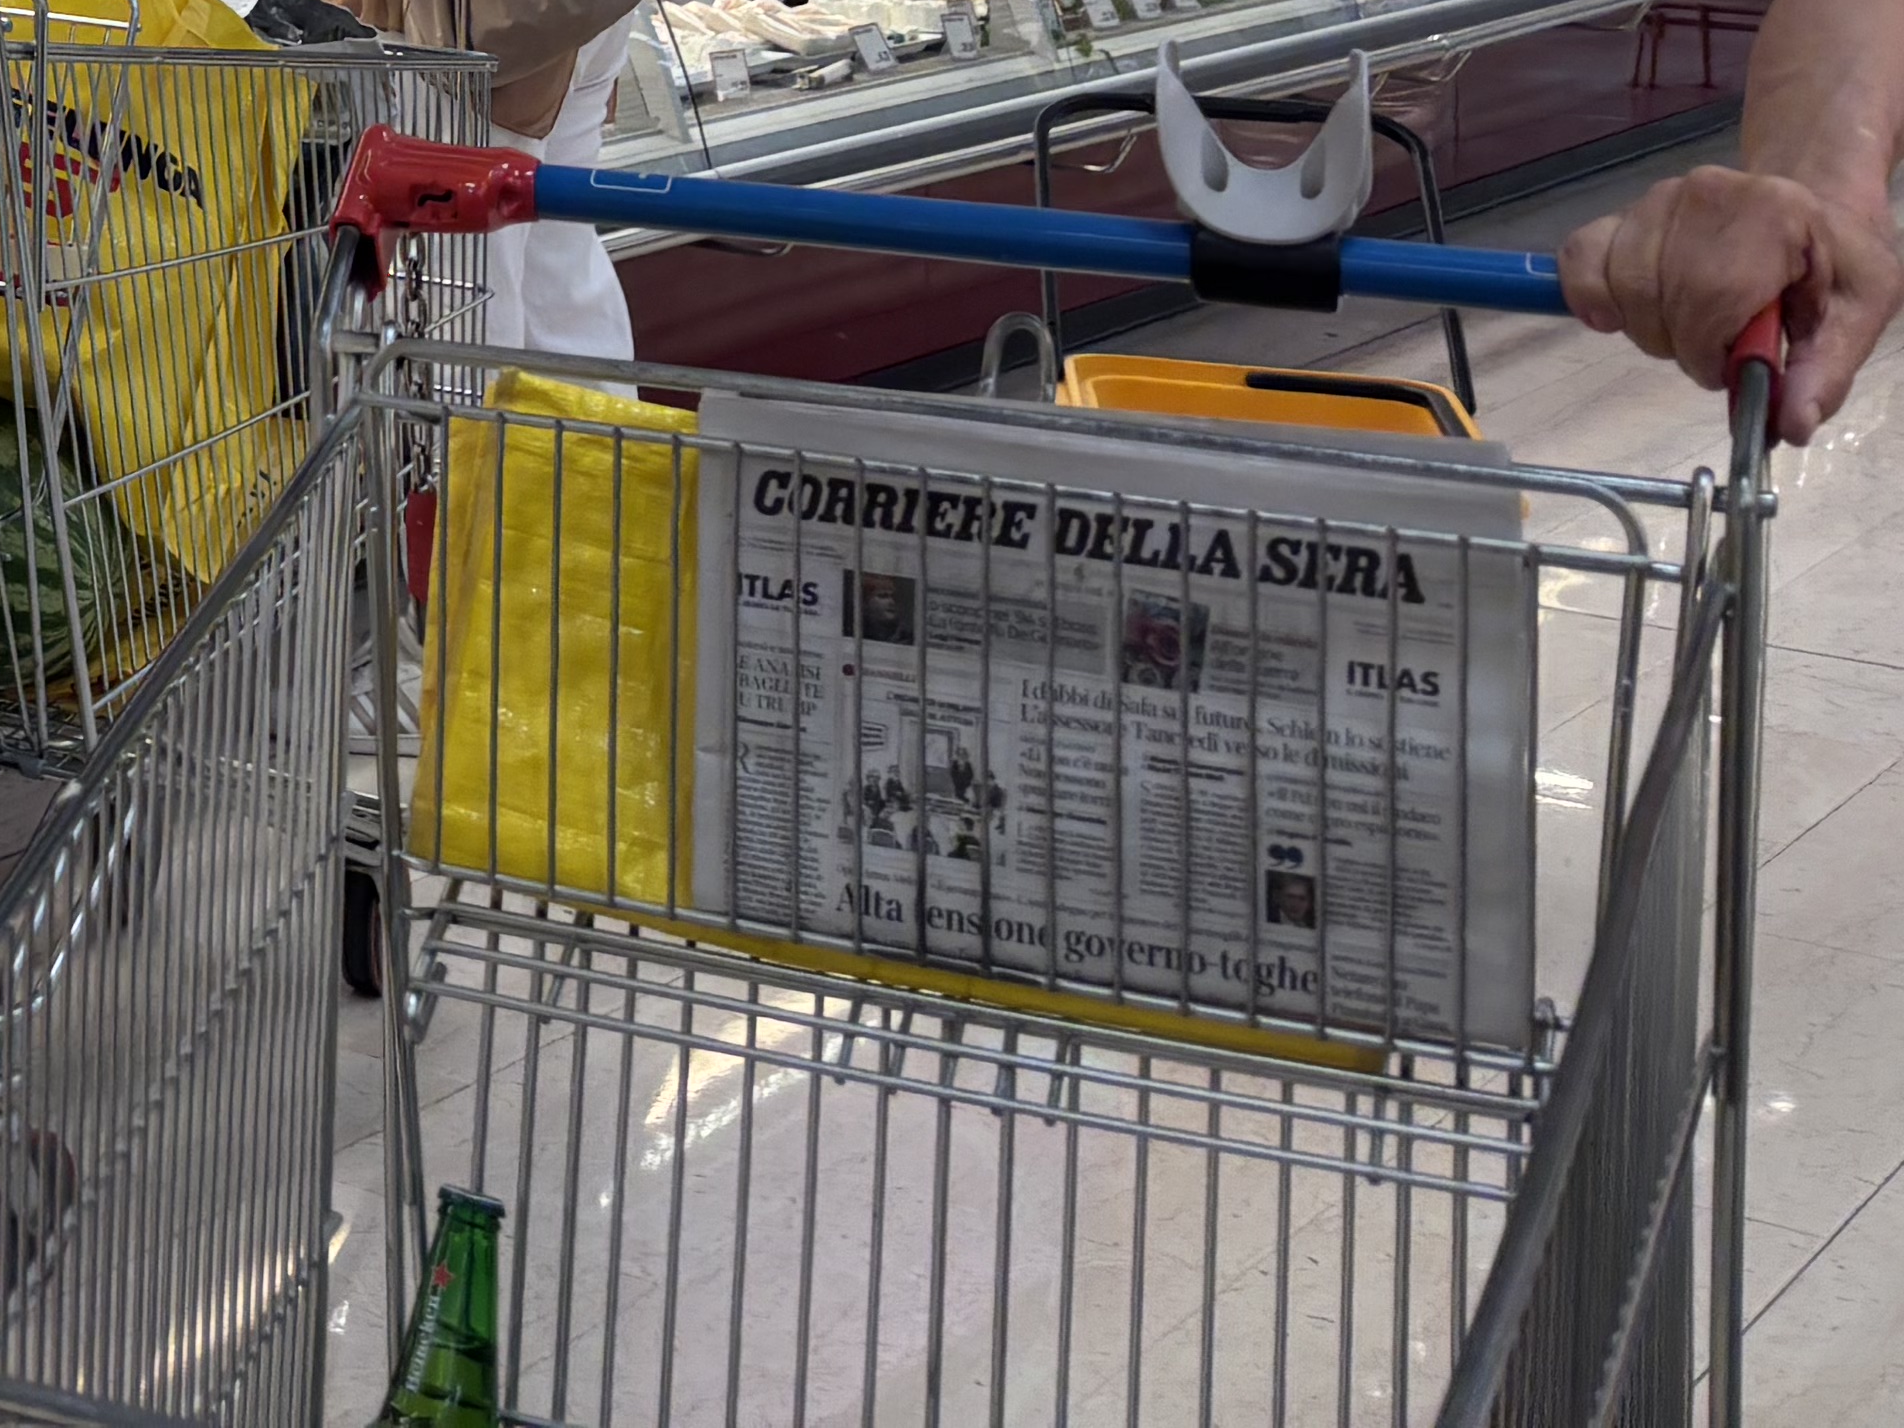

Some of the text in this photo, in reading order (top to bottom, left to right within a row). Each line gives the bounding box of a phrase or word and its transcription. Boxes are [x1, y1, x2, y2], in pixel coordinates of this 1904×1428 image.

[752, 468, 1426, 605] CORRIERE DELLA SERA
[835, 882, 903, 924] Alta
[405, 1293, 442, 1393] Heineken
